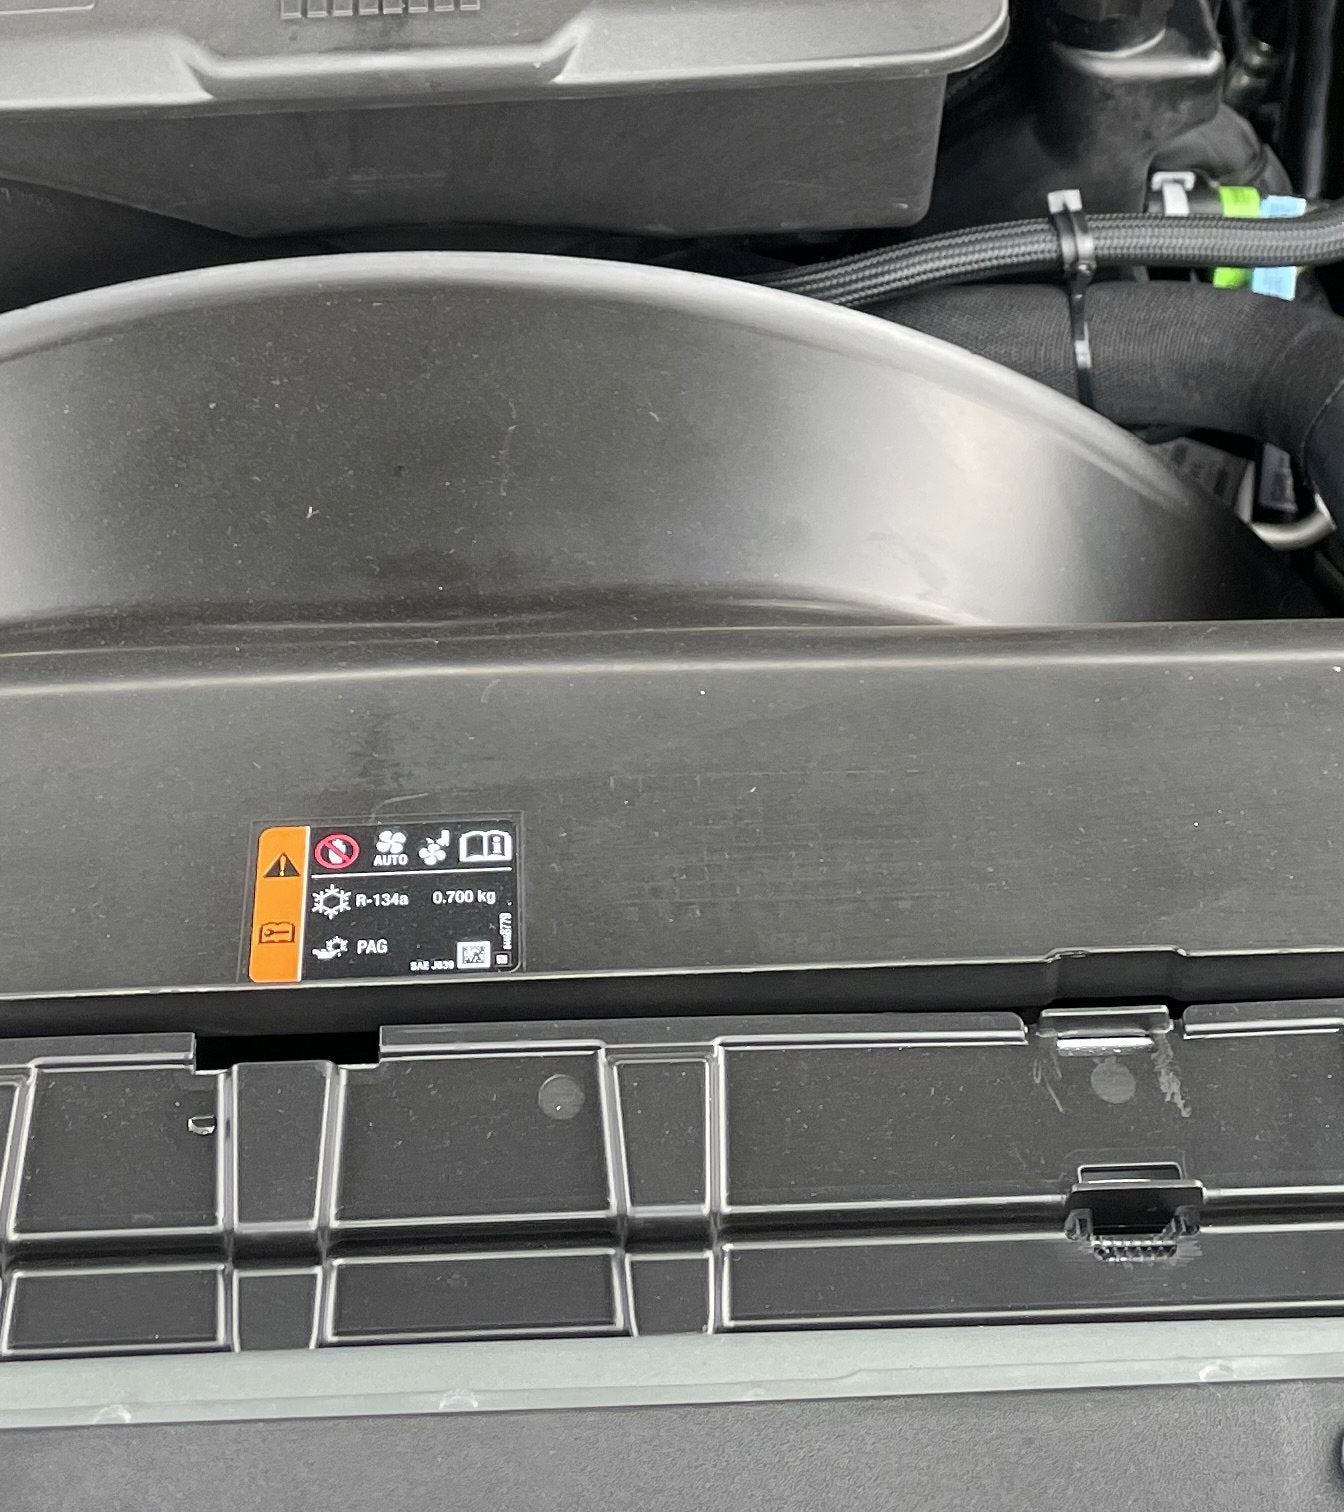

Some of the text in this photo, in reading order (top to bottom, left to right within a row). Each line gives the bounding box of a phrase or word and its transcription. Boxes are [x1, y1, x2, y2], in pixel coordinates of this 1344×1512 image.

[373, 854, 408, 867] AUTO
[355, 889, 497, 908] R-134a 0.700 kg
[356, 939, 389, 955] PAG
[409, 960, 430, 971] SAE
